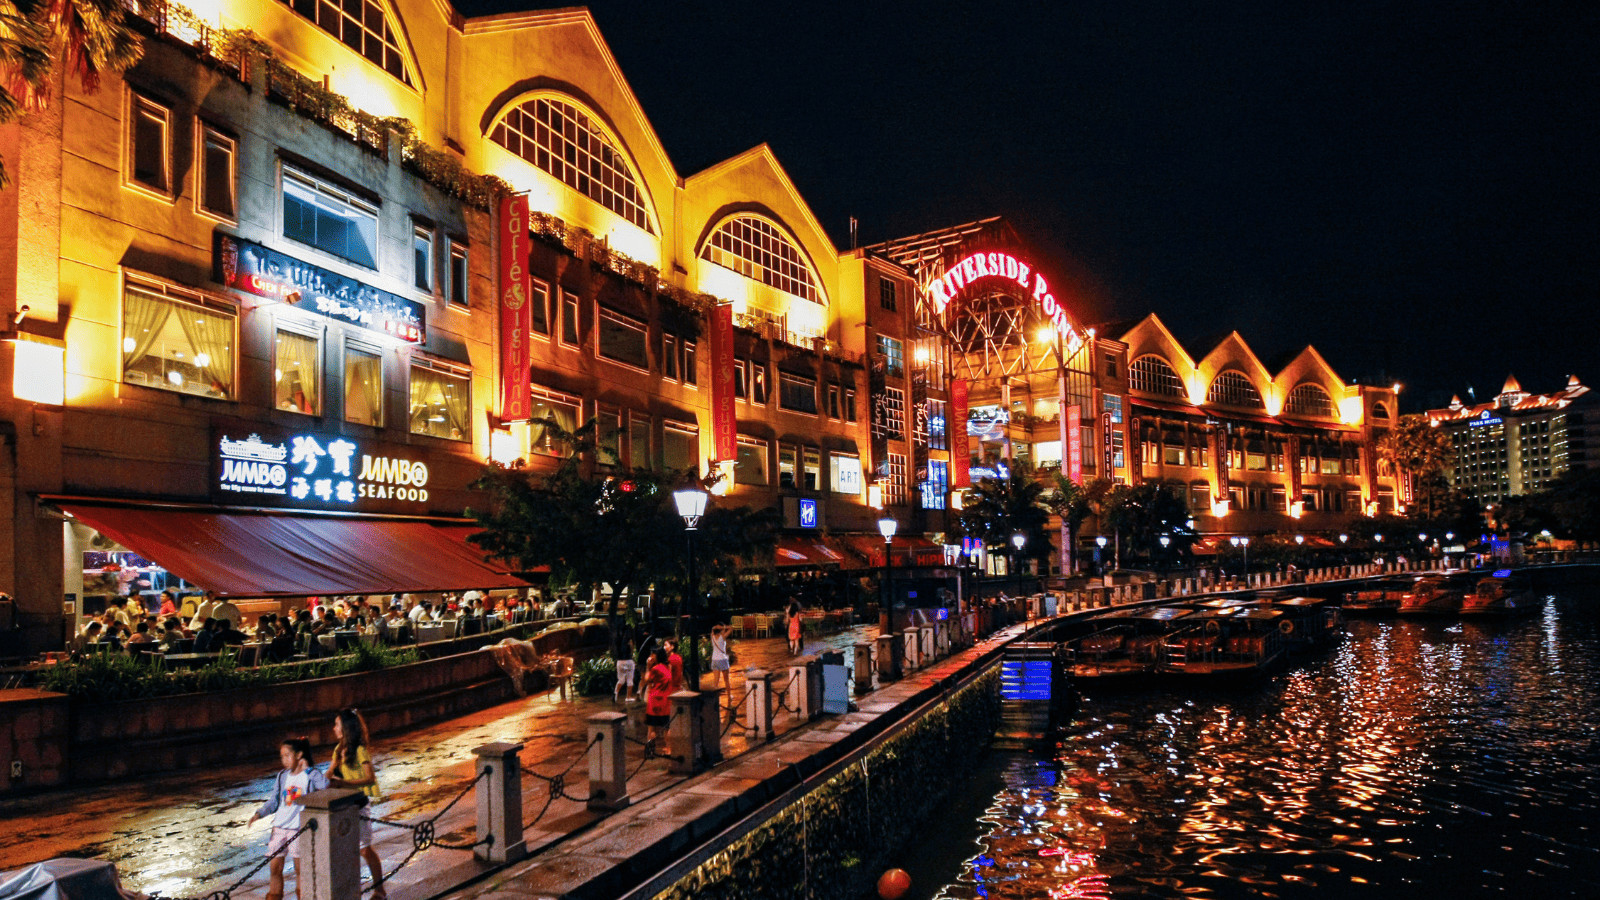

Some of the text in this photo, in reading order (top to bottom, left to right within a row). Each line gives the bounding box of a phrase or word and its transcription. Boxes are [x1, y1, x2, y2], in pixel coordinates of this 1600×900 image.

[928, 252, 1083, 354] RIVERSIDE POINT
[220, 460, 287, 486] JUMBO
[358, 455, 428, 487] JUMBO
[840, 470, 857, 484] ART
[358, 483, 428, 502] SEAFOOD
